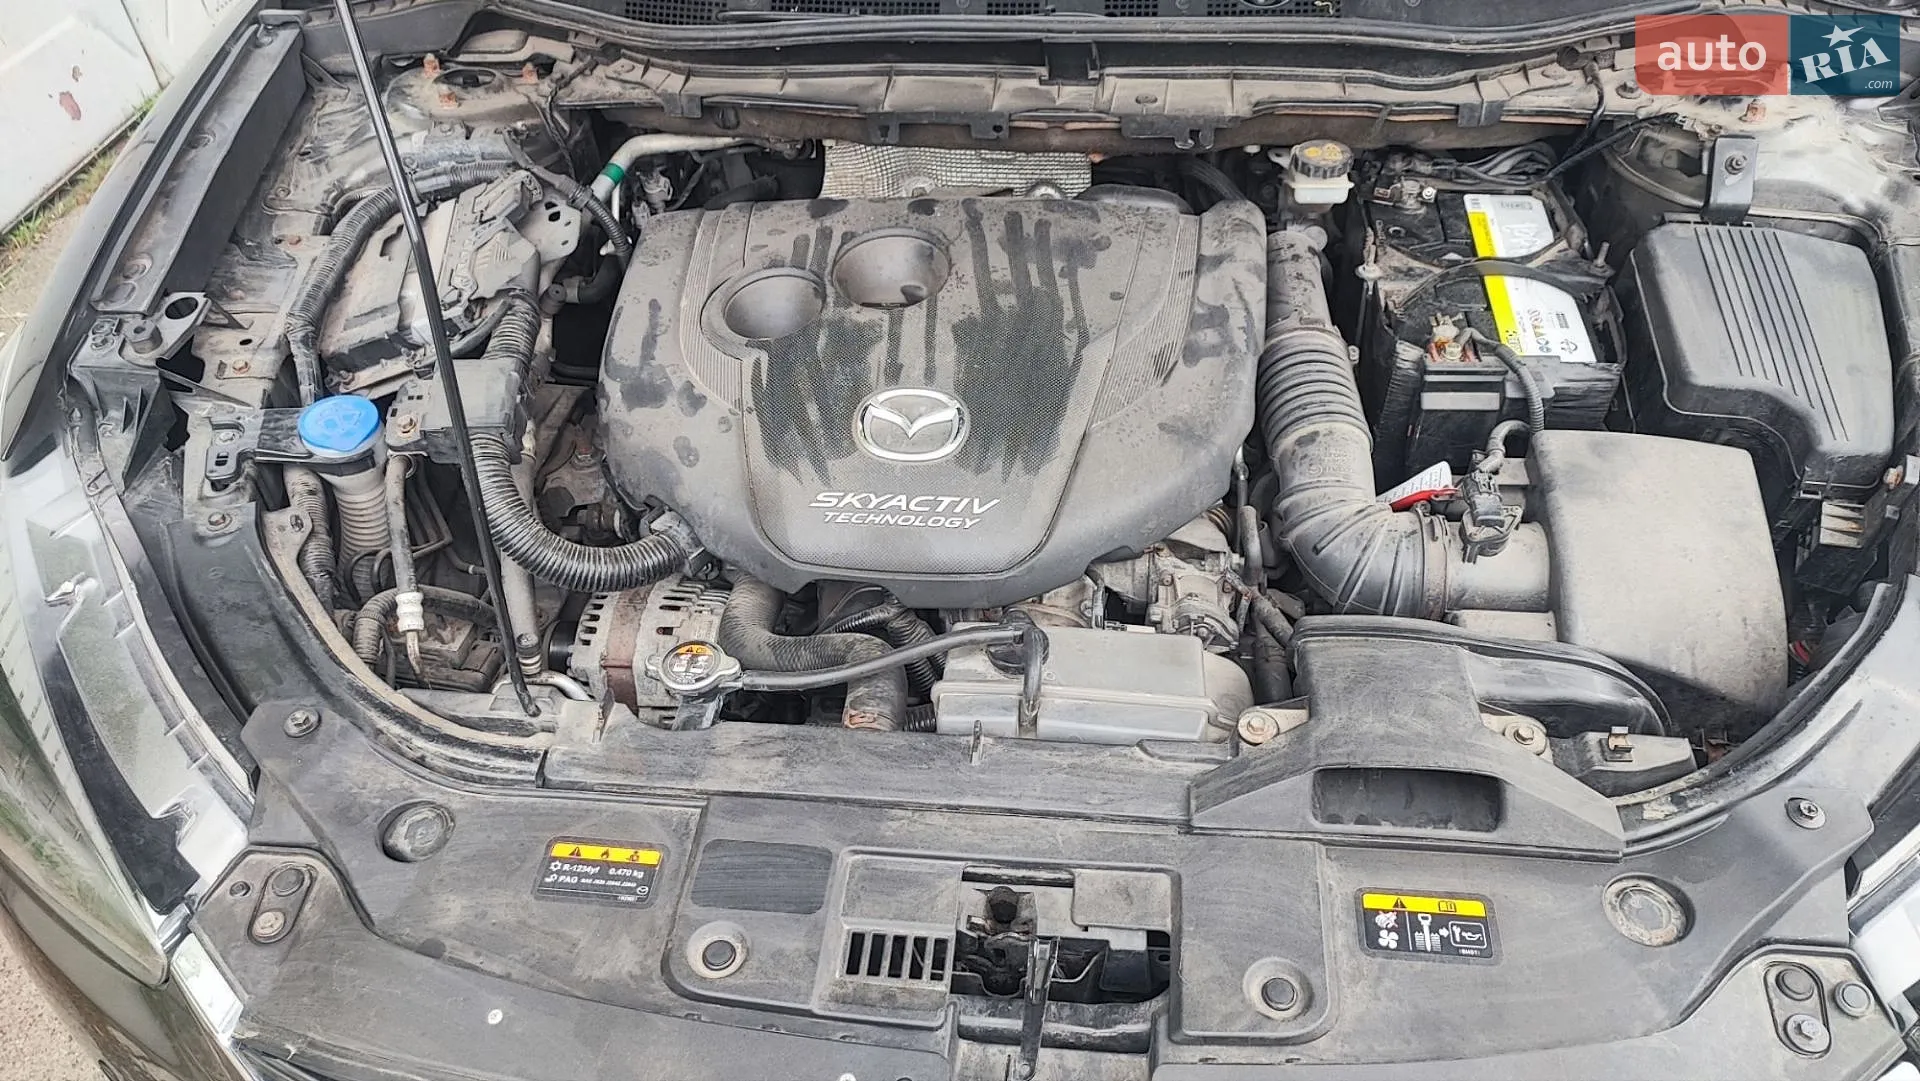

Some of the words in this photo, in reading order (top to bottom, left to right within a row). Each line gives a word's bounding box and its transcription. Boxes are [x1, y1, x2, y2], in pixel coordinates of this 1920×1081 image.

[808, 491, 1001, 514] SKYACTIV
[823, 511, 981, 529] TECHNOLOGY
[562, 863, 600, 875] R-1234yf
[633, 869, 645, 879] kg
